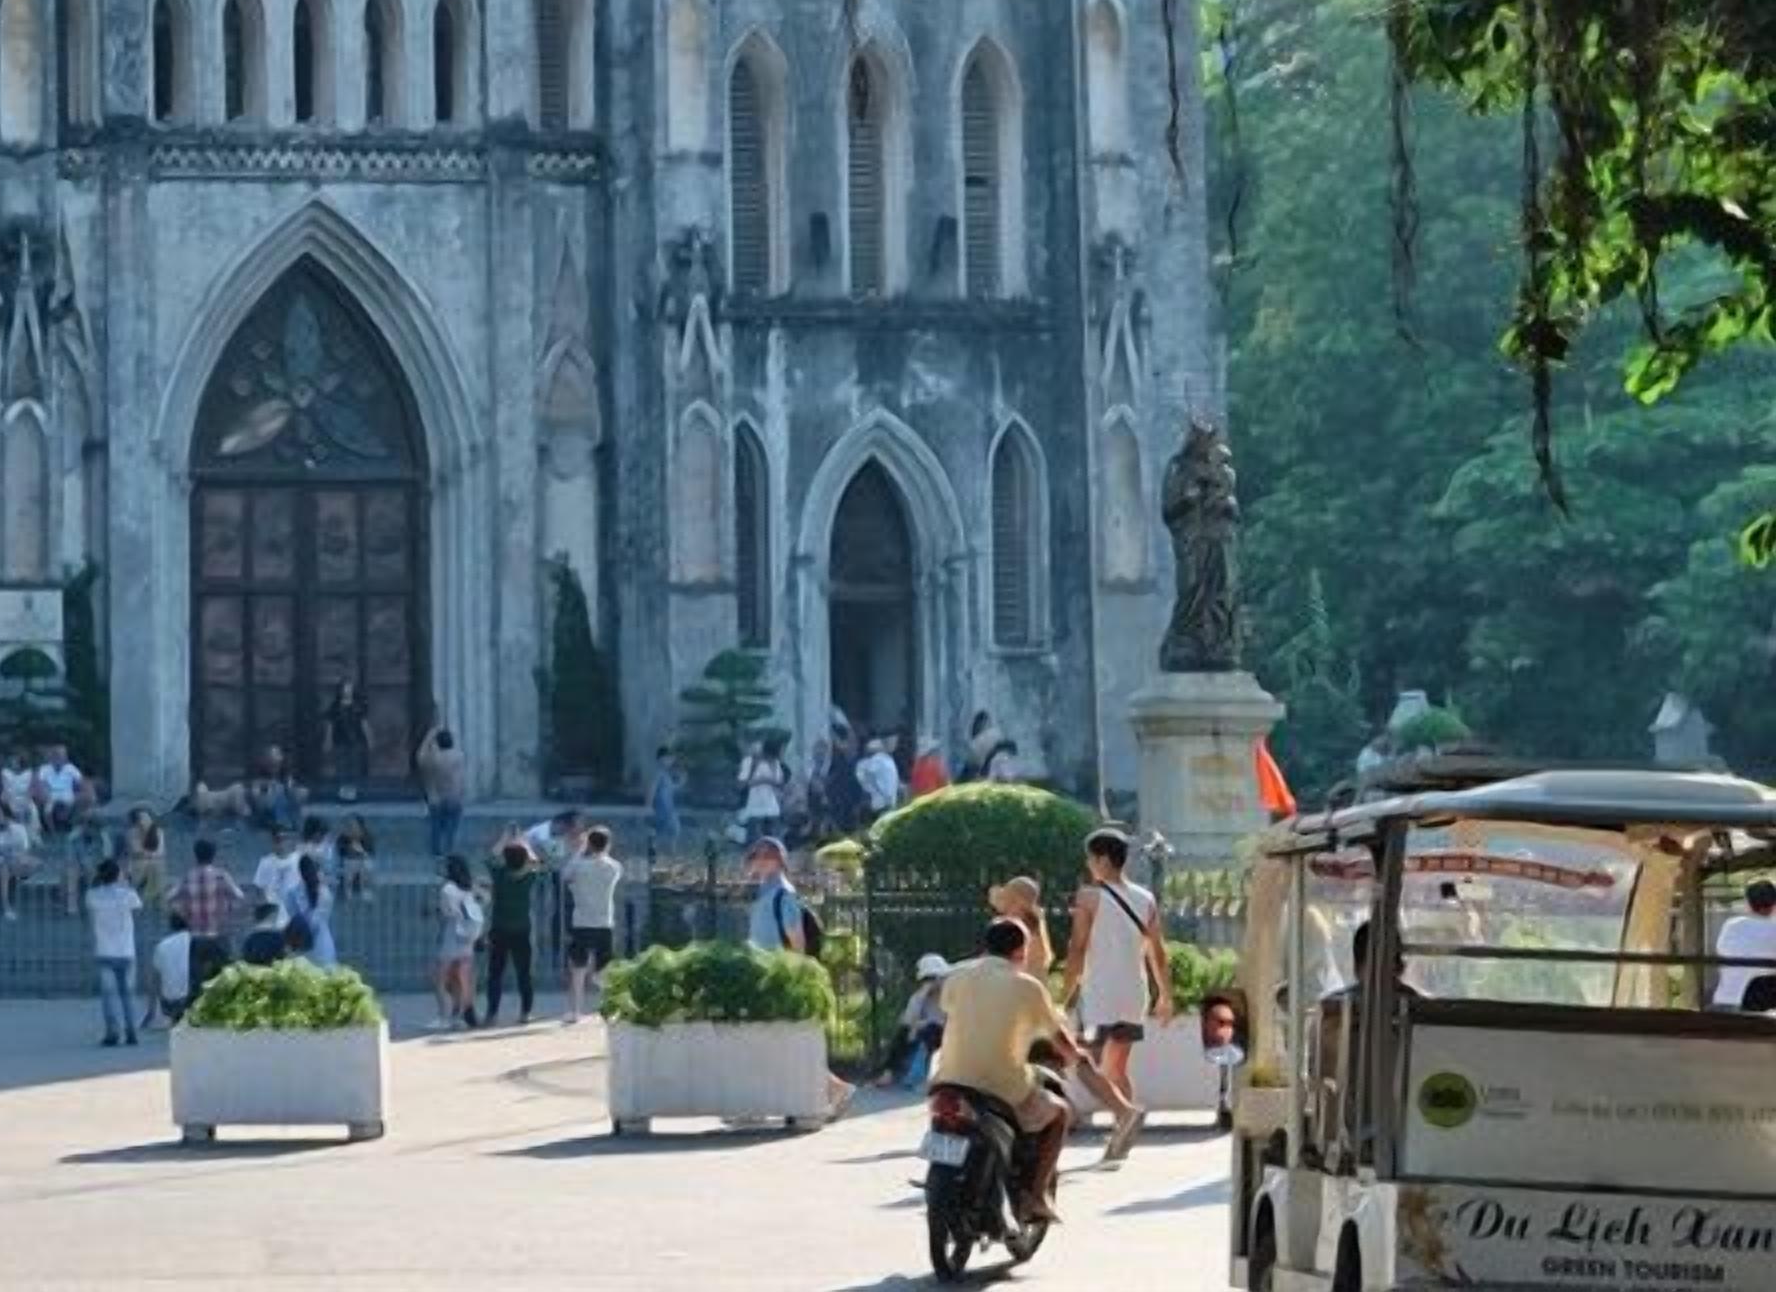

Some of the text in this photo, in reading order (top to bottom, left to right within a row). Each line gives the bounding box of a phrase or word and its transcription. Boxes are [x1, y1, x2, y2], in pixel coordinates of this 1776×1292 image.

[1456, 1199, 1531, 1240] Du
[1540, 1257, 1725, 1282] GREEN TOURISM
